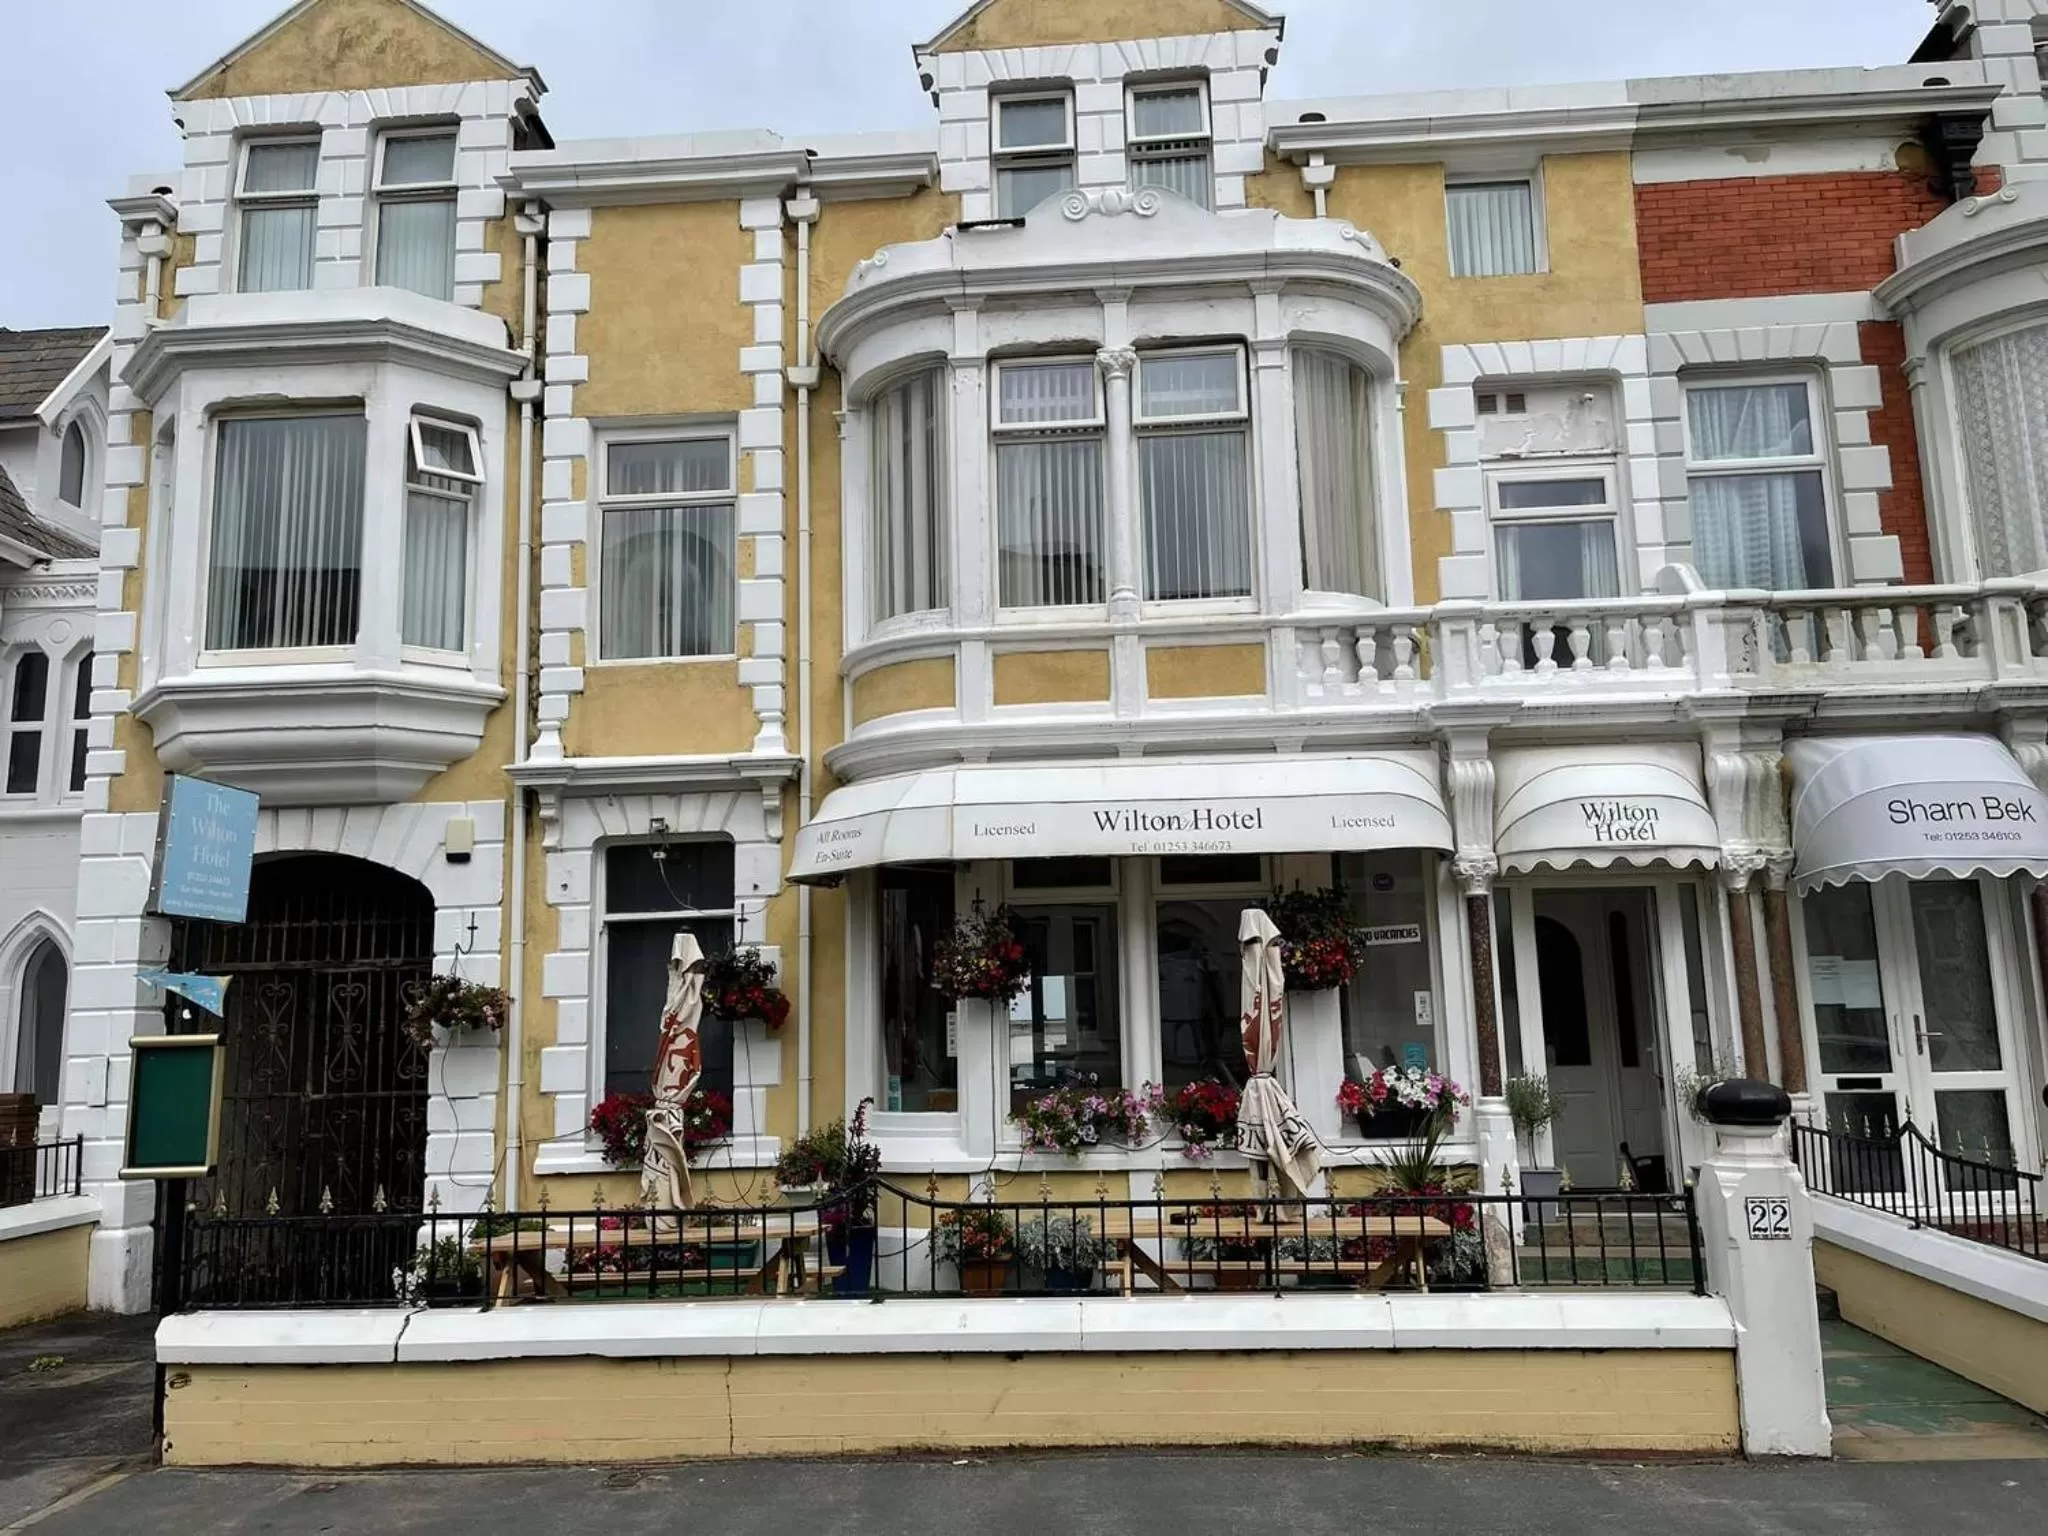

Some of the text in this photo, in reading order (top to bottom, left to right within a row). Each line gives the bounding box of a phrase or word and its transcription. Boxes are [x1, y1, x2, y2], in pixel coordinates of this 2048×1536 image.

[206, 793, 230, 815] The
[1580, 801, 1660, 822] Wilton
[1888, 796, 2037, 824] Sharn Bek
[192, 816, 238, 843] Wilton
[1093, 807, 1263, 832] Wilton Hotel
[1331, 814, 1395, 829] Licensed
[831, 829, 862, 842] Rooms
[973, 823, 1036, 837] Licensed
[1594, 822, 1658, 842] Hotel
[1944, 832, 1980, 841] 01253
[1153, 841, 1188, 852] 01253
[192, 845, 230, 869] Hotel
[1374, 928, 1418, 941] VACANCIES
[1750, 1204, 1790, 1233] 22
